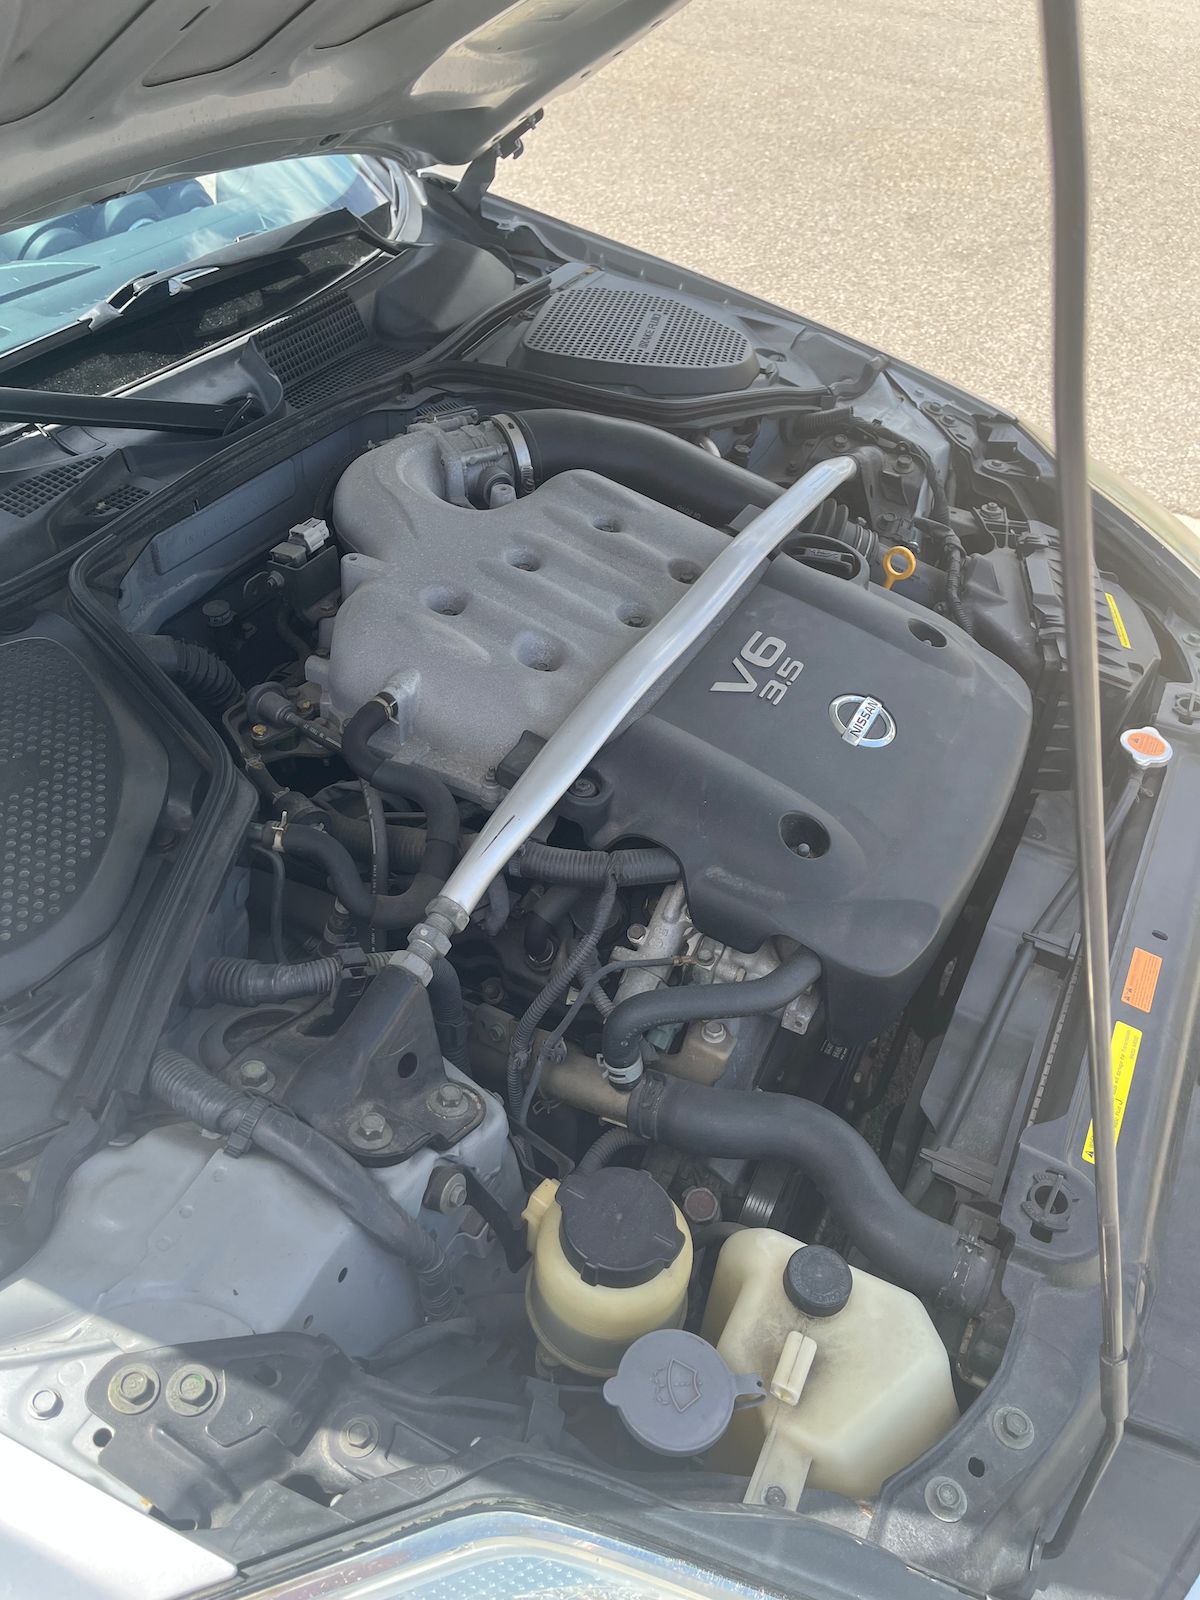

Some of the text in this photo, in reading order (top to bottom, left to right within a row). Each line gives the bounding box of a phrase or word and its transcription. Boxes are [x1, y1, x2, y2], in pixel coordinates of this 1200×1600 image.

[709, 631, 787, 693] V6
[758, 657, 804, 706] 3.5
[849, 698, 879, 738] NISSAN
